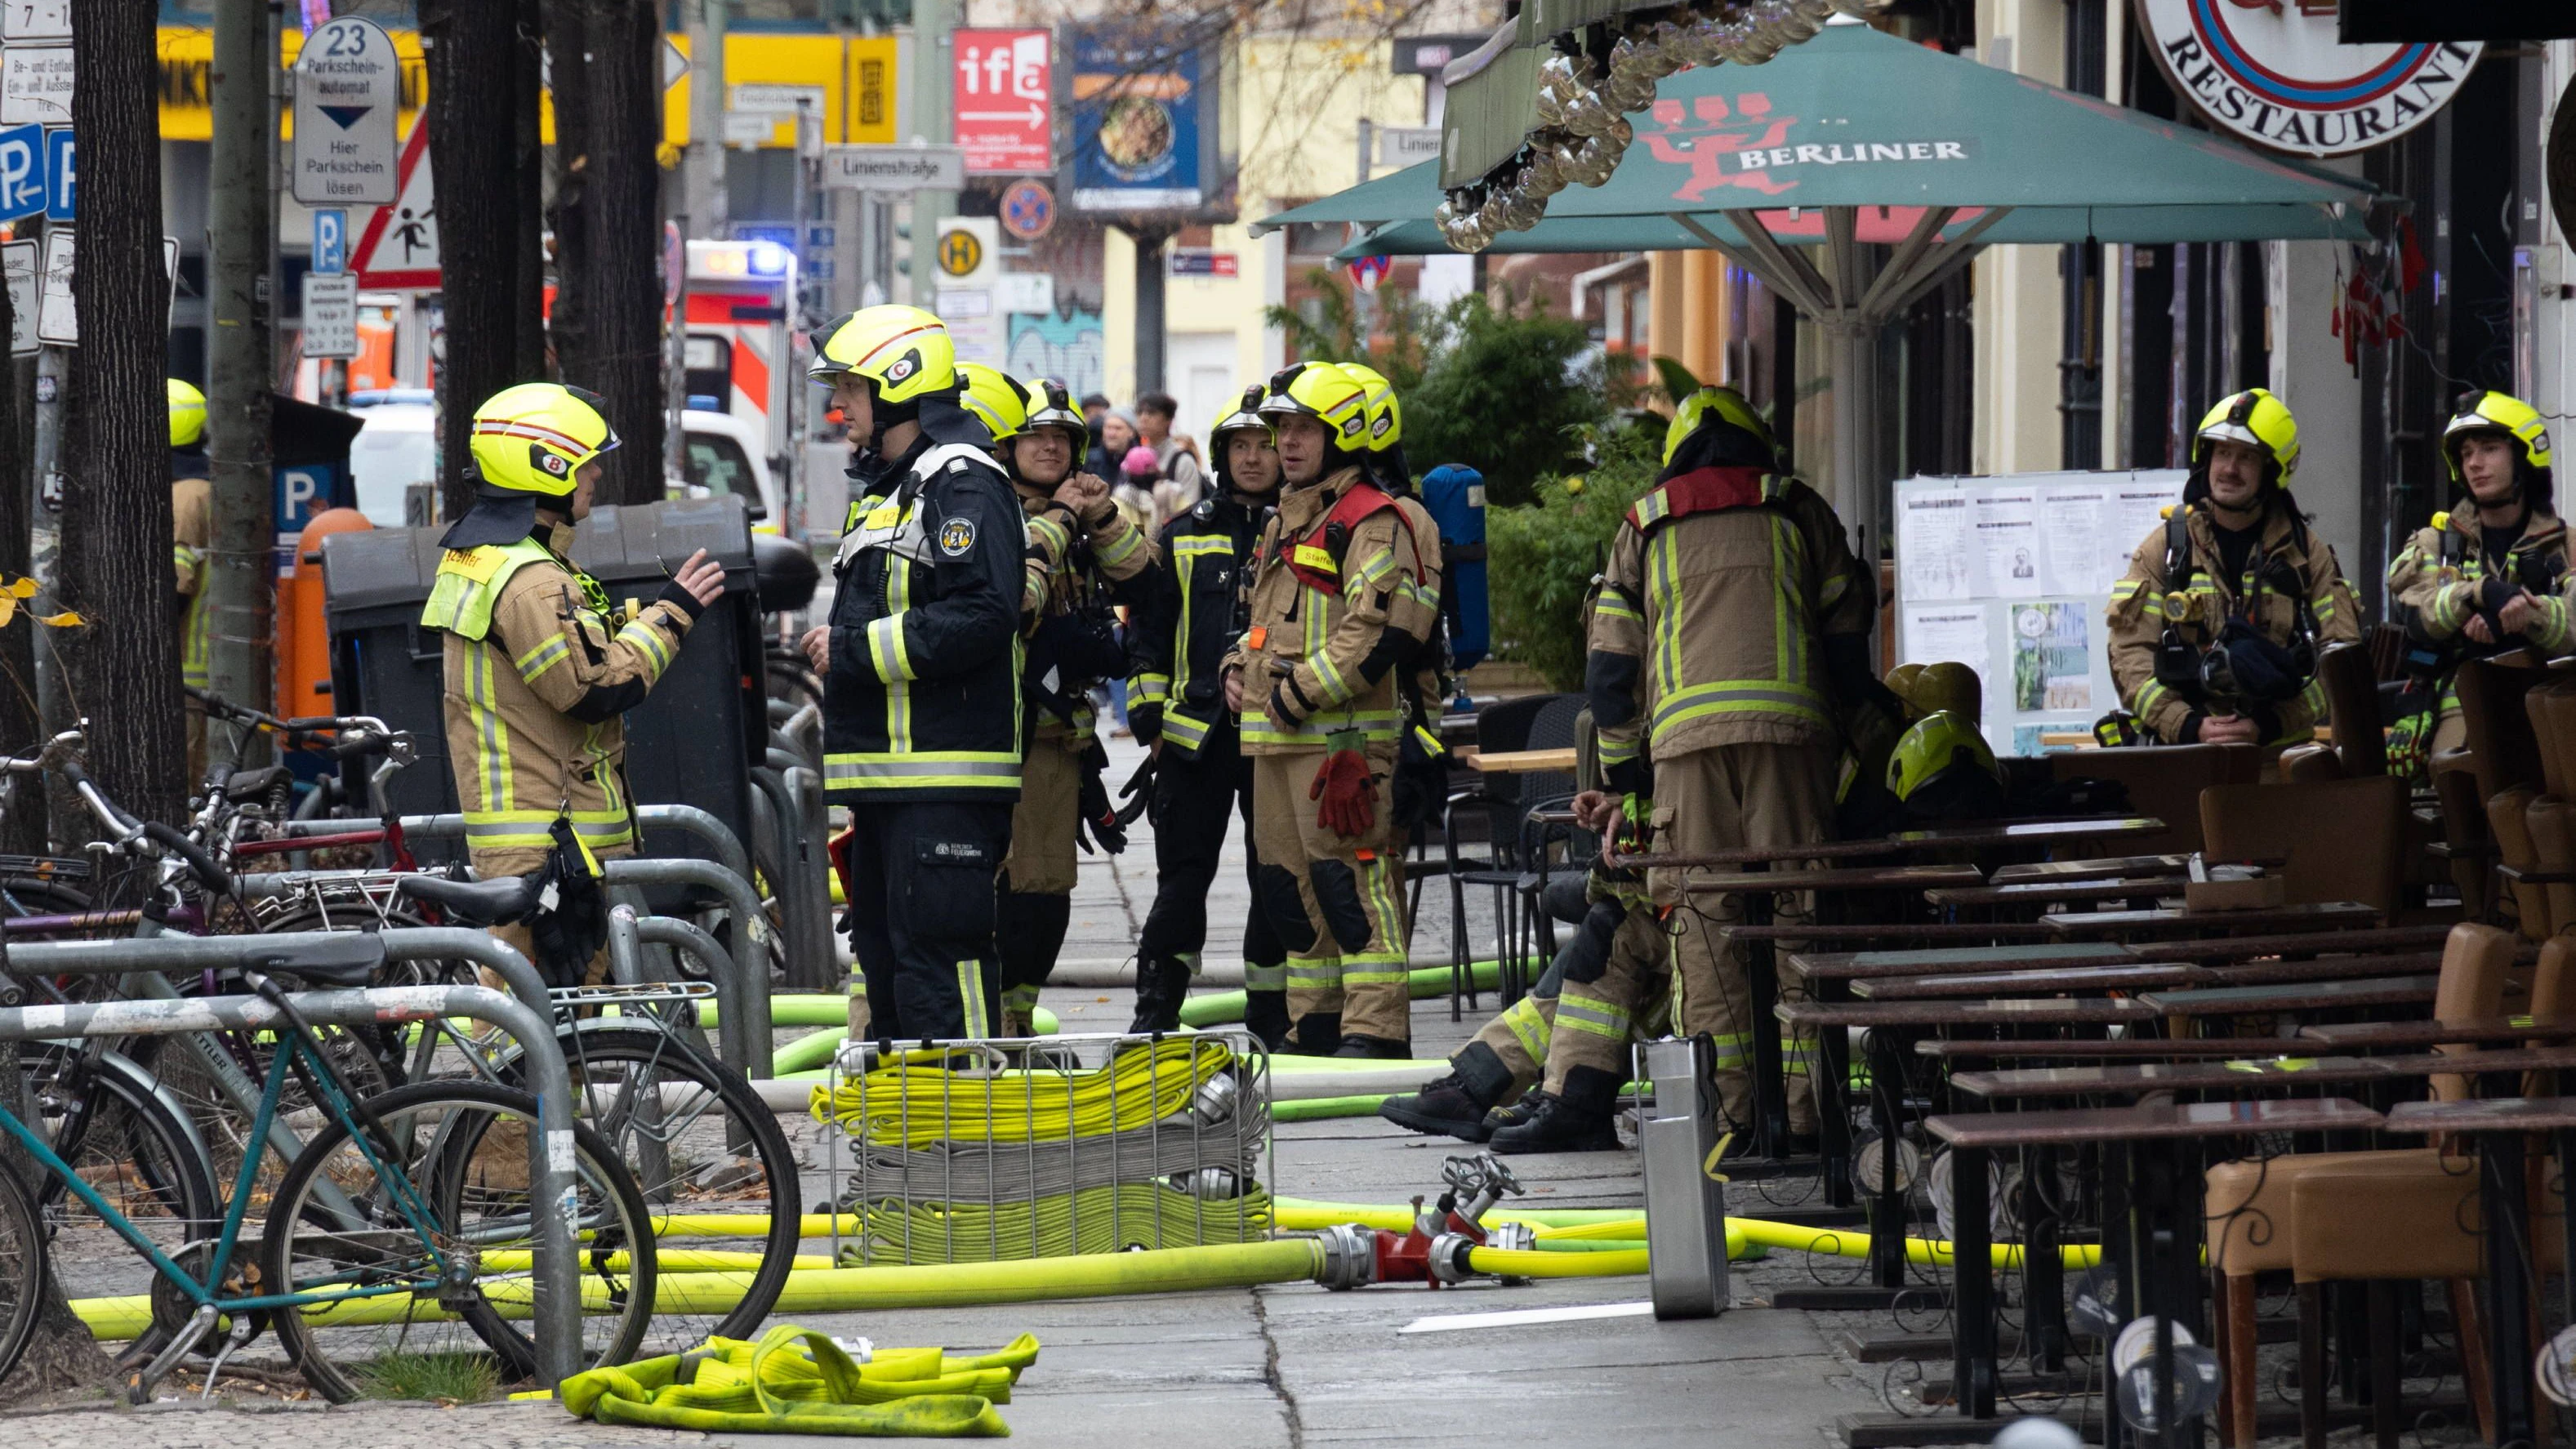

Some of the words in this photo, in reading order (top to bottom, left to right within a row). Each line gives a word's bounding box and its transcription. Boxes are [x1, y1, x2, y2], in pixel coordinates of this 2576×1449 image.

[25, 5, 33, 28] 7
[326, 24, 366, 56] 23
[31, 60, 47, 73] und
[307, 58, 385, 74] Parkschein-
[319, 80, 370, 94] automat
[2163, 30, 2476, 147] RESTAURANT
[330, 140, 359, 154] Hier
[1738, 141, 1968, 170] BERLINER
[0, 139, 32, 210] P
[305, 158, 384, 174] Parkschein
[326, 179, 364, 195] lösen
[319, 215, 338, 267] P
[950, 241, 969, 265] H
[894, 363, 907, 377] C
[548, 457, 561, 471] B
[284, 471, 316, 519] P
